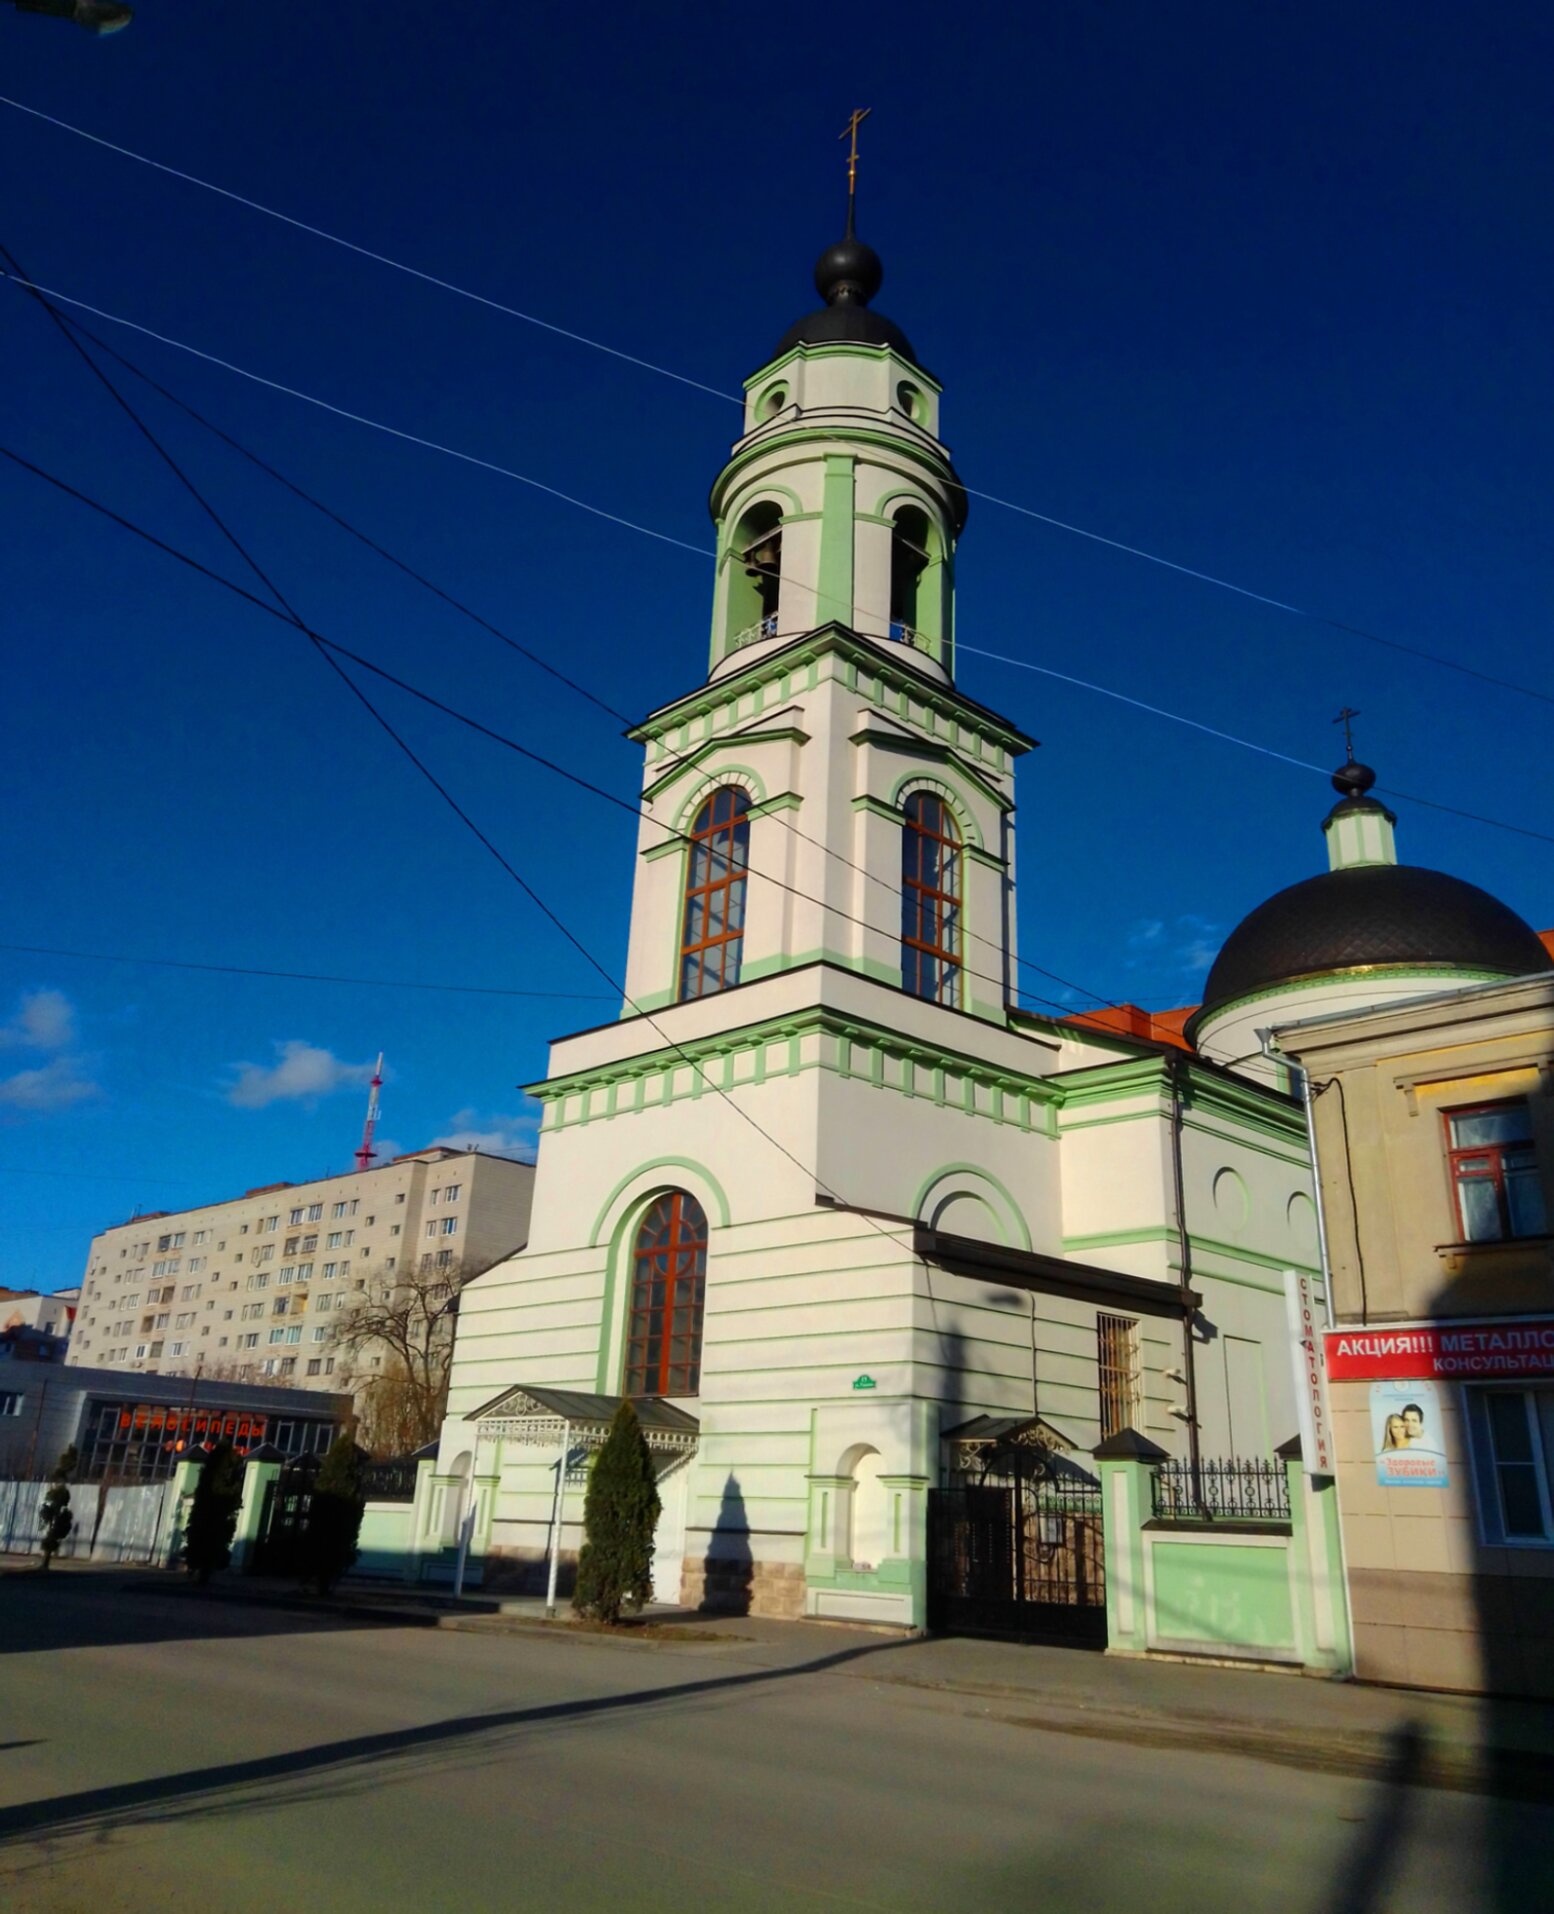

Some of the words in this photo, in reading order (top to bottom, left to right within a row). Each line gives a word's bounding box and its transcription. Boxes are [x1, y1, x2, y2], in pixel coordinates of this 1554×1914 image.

[1336, 1336, 1433, 1358] АКЦИЯ!!!
[1300, 1278, 1327, 1468] СТОМАТОЛОГИЯ
[119, 1411, 265, 1437] ВЕЛОСИПЕДЫ
